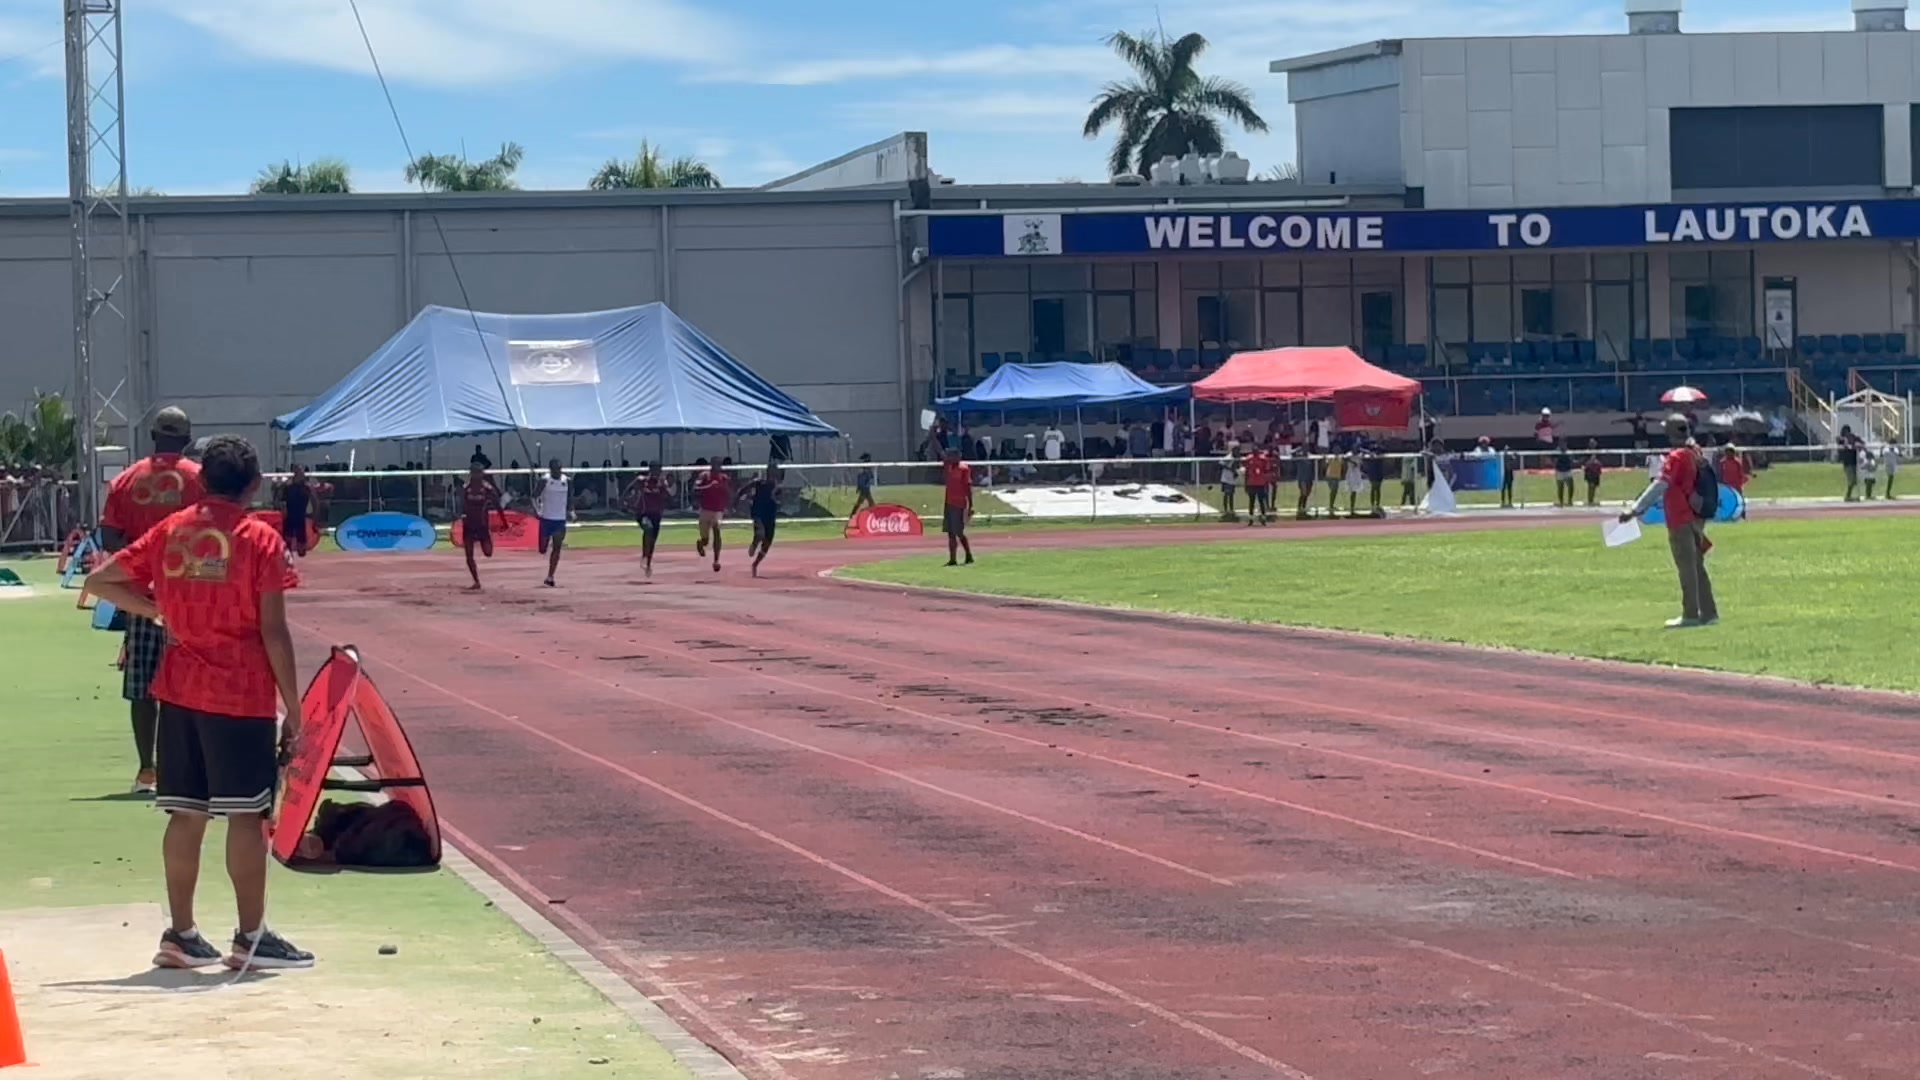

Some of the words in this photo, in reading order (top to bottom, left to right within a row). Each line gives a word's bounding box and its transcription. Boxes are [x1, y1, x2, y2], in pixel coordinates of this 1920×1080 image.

[1144, 215, 1383, 248] WELCOME
[1488, 213, 1551, 246] TO
[1645, 205, 1872, 242] LAUTOKA
